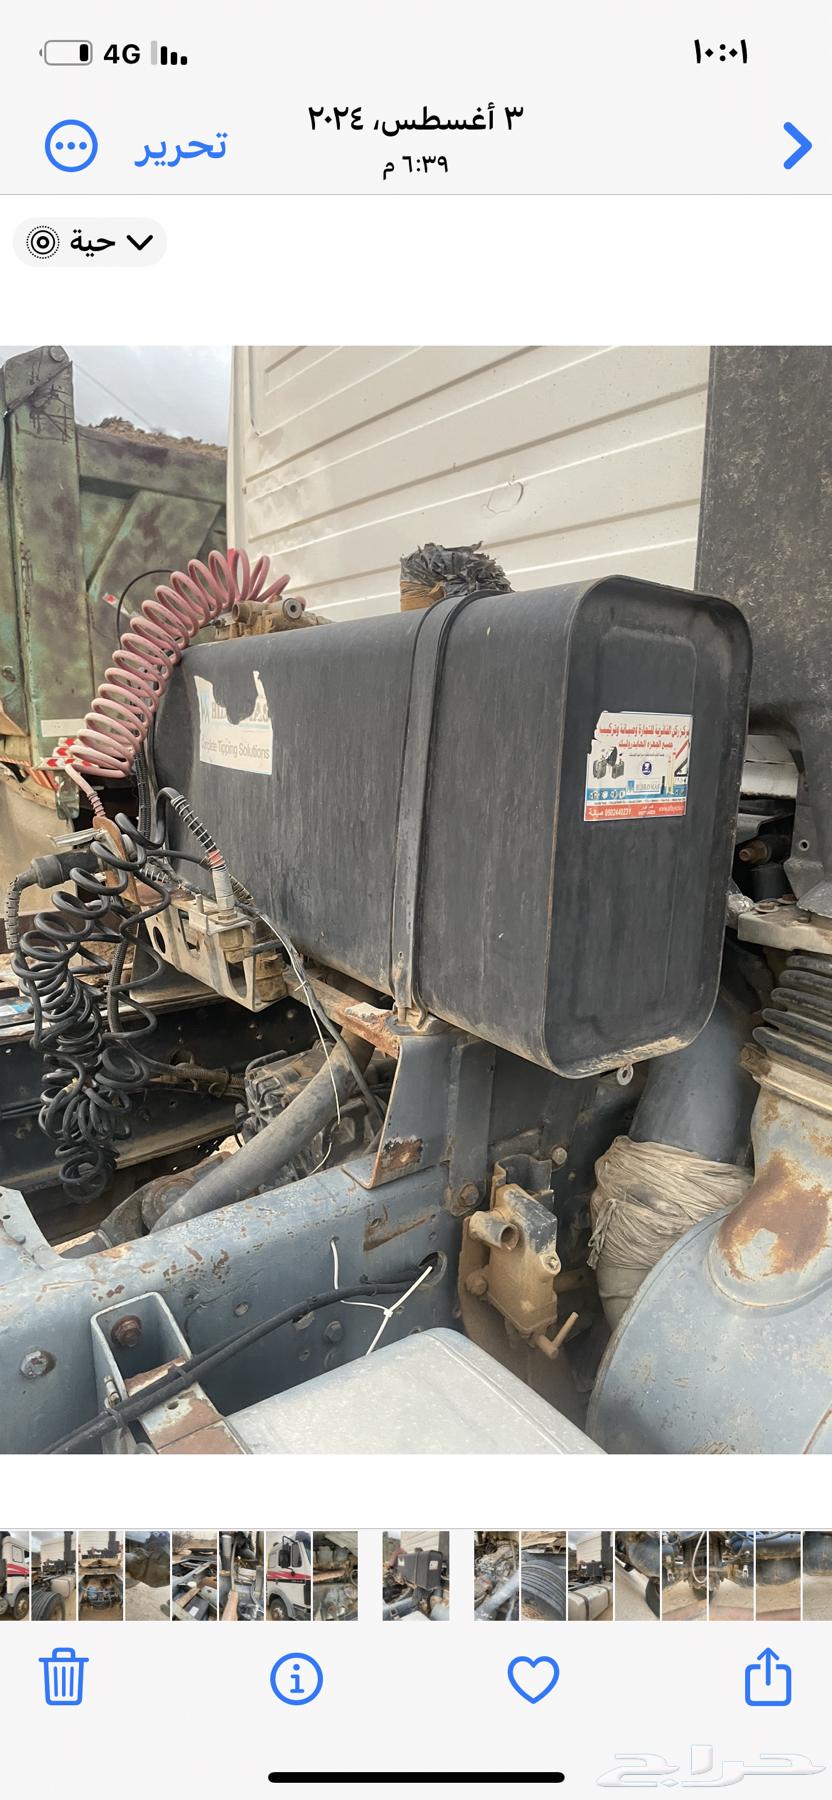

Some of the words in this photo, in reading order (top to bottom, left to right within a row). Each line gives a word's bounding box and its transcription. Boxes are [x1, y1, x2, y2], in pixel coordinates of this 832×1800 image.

[104, 44, 140, 64] 4G
[694, 39, 748, 65] ١٠:٠١
[308, 107, 363, 130] ٢٠٢٤
[505, 107, 523, 130] ٣
[134, 132, 229, 168] تحرير
[383, 161, 395, 180] م
[402, 156, 449, 174] ٦:٣٩
[70, 229, 116, 258] حية
[218, 739, 238, 757] Tipping
[239, 742, 271, 760] Solutions
